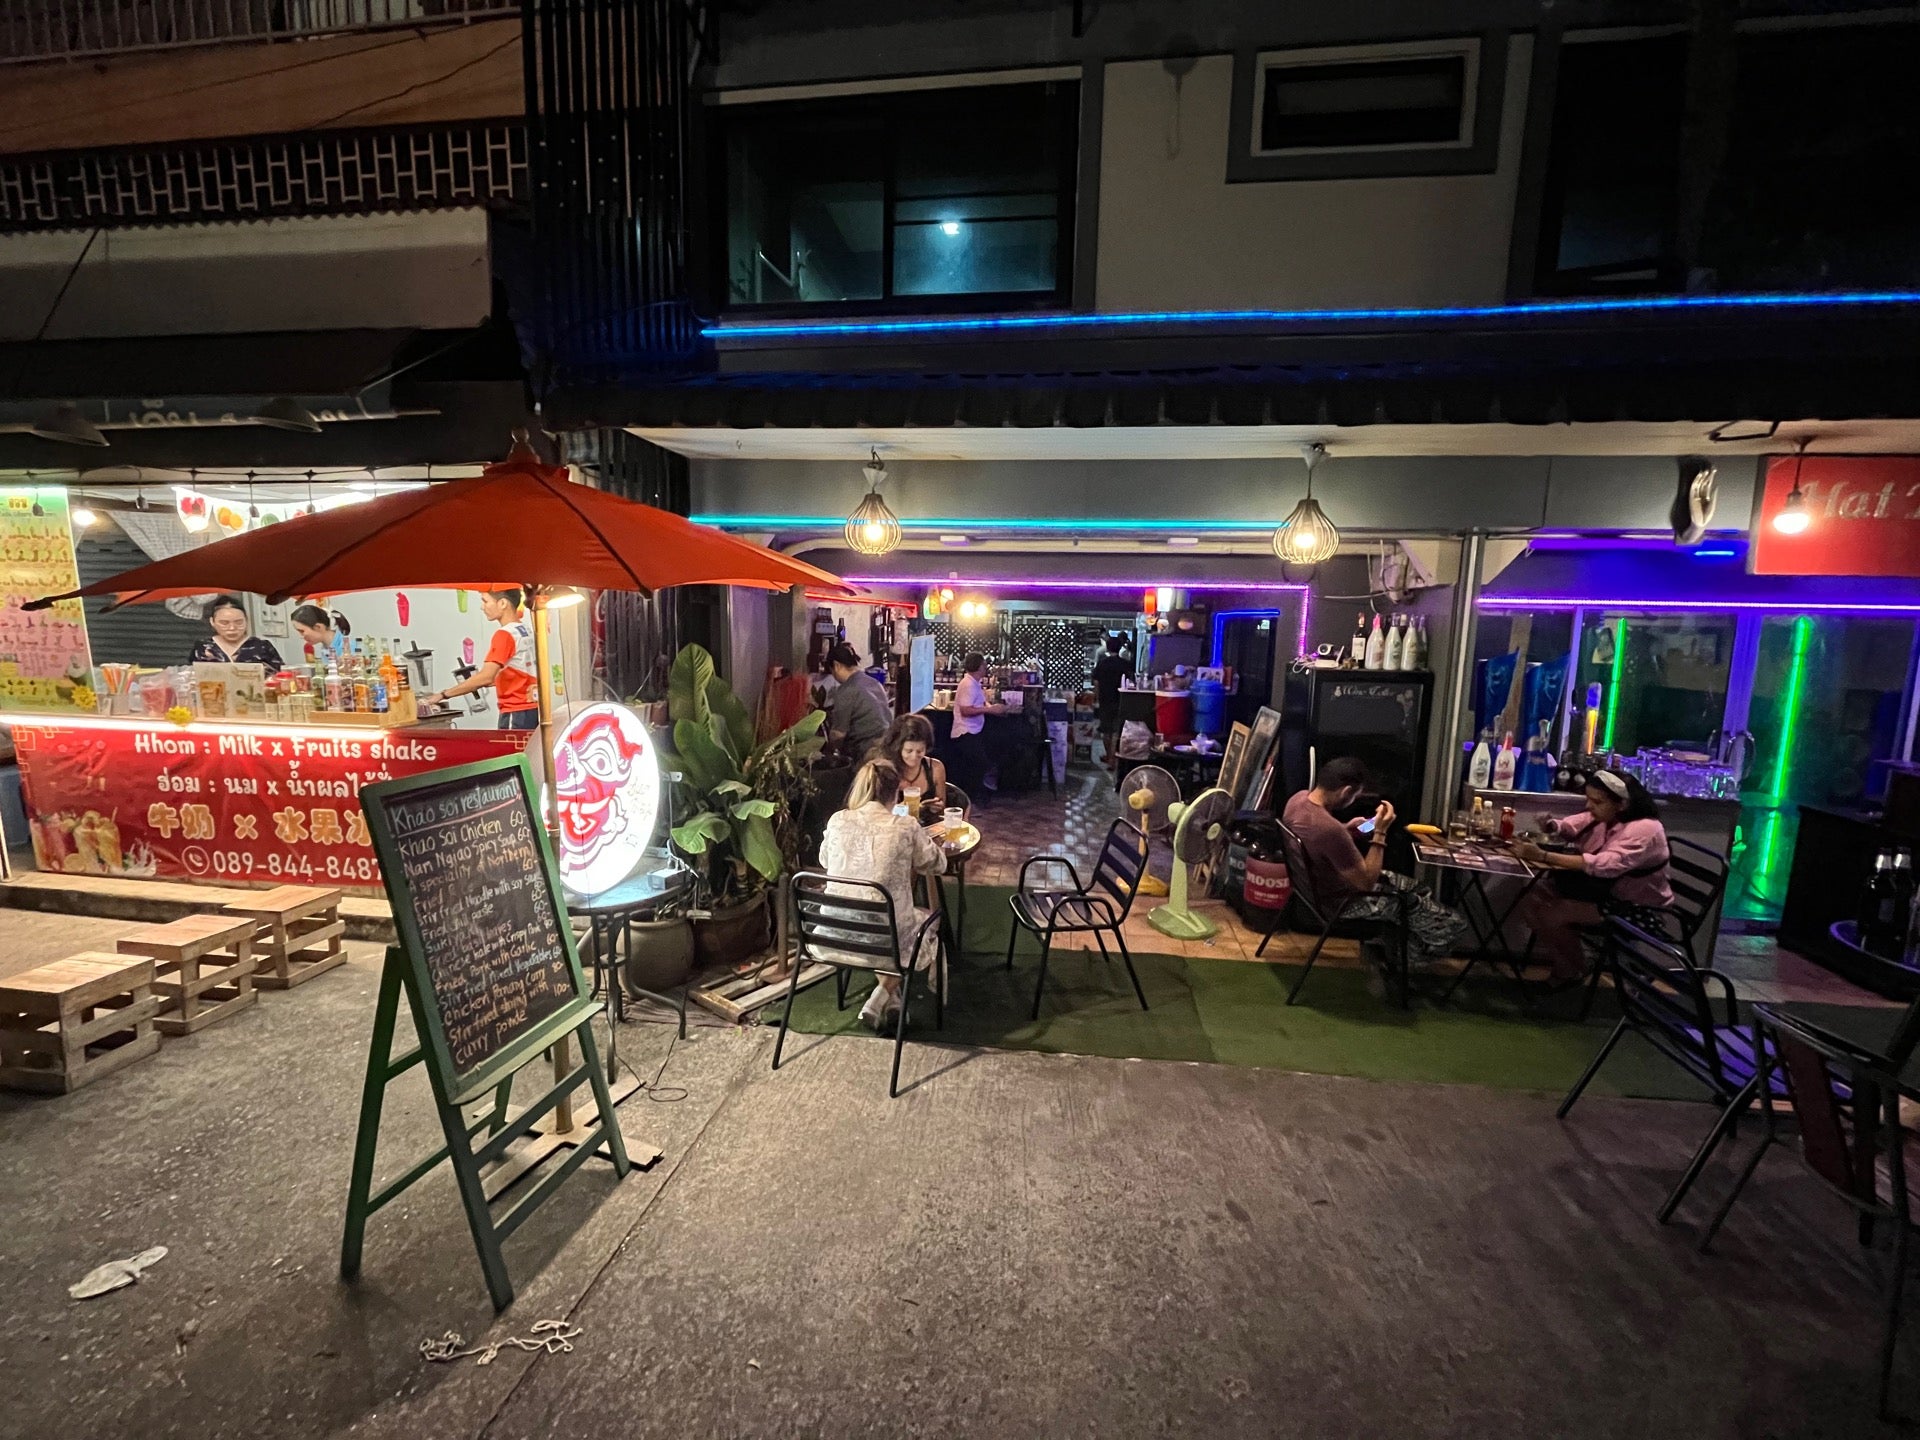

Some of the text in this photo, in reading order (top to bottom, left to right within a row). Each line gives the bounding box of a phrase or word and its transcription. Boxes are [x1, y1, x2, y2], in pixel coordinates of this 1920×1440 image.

[134, 733, 196, 756] Hhom
[218, 734, 263, 757] Milk
[291, 736, 362, 759] Fruits
[370, 739, 437, 762] shake
[223, 776, 257, 795] นม
[147, 802, 216, 840] 牛奶
[461, 818, 502, 842] Chicken
[403, 860, 433, 878] Nam
[444, 993, 490, 1026] Chicken
